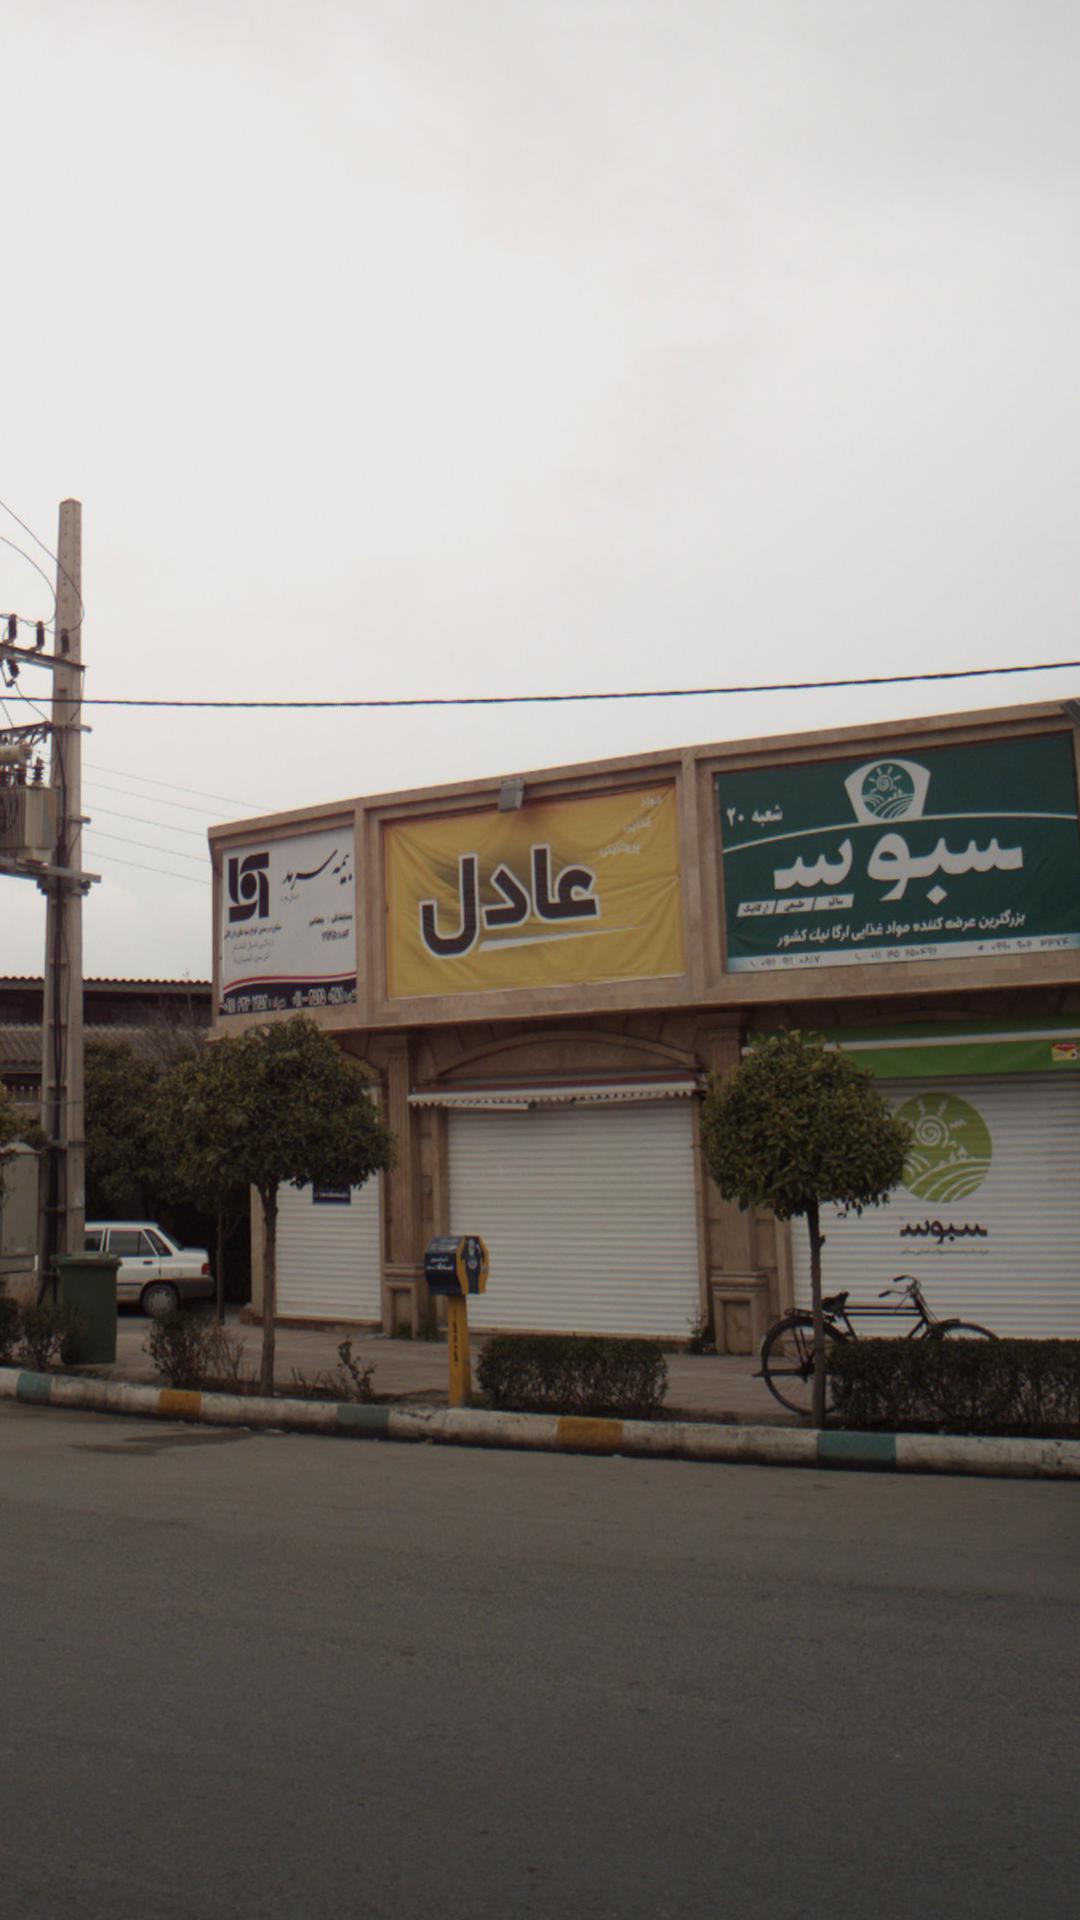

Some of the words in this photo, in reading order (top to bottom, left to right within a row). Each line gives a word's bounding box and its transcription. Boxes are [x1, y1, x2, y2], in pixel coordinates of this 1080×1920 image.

[726, 807, 745, 827] ۲۰
[751, 804, 784, 828] شعبه
[331, 852, 354, 886] بیمه
[773, 832, 1024, 906] سبوس
[419, 844, 601, 958] عادل
[886, 919, 911, 938] مواد
[912, 916, 944, 932] کننده
[944, 916, 976, 932] عرضه
[978, 908, 1027, 929] بزرگترین
[776, 928, 808, 949] کشور
[851, 923, 883, 942] غذایی
[899, 1219, 988, 1245] سبوس
